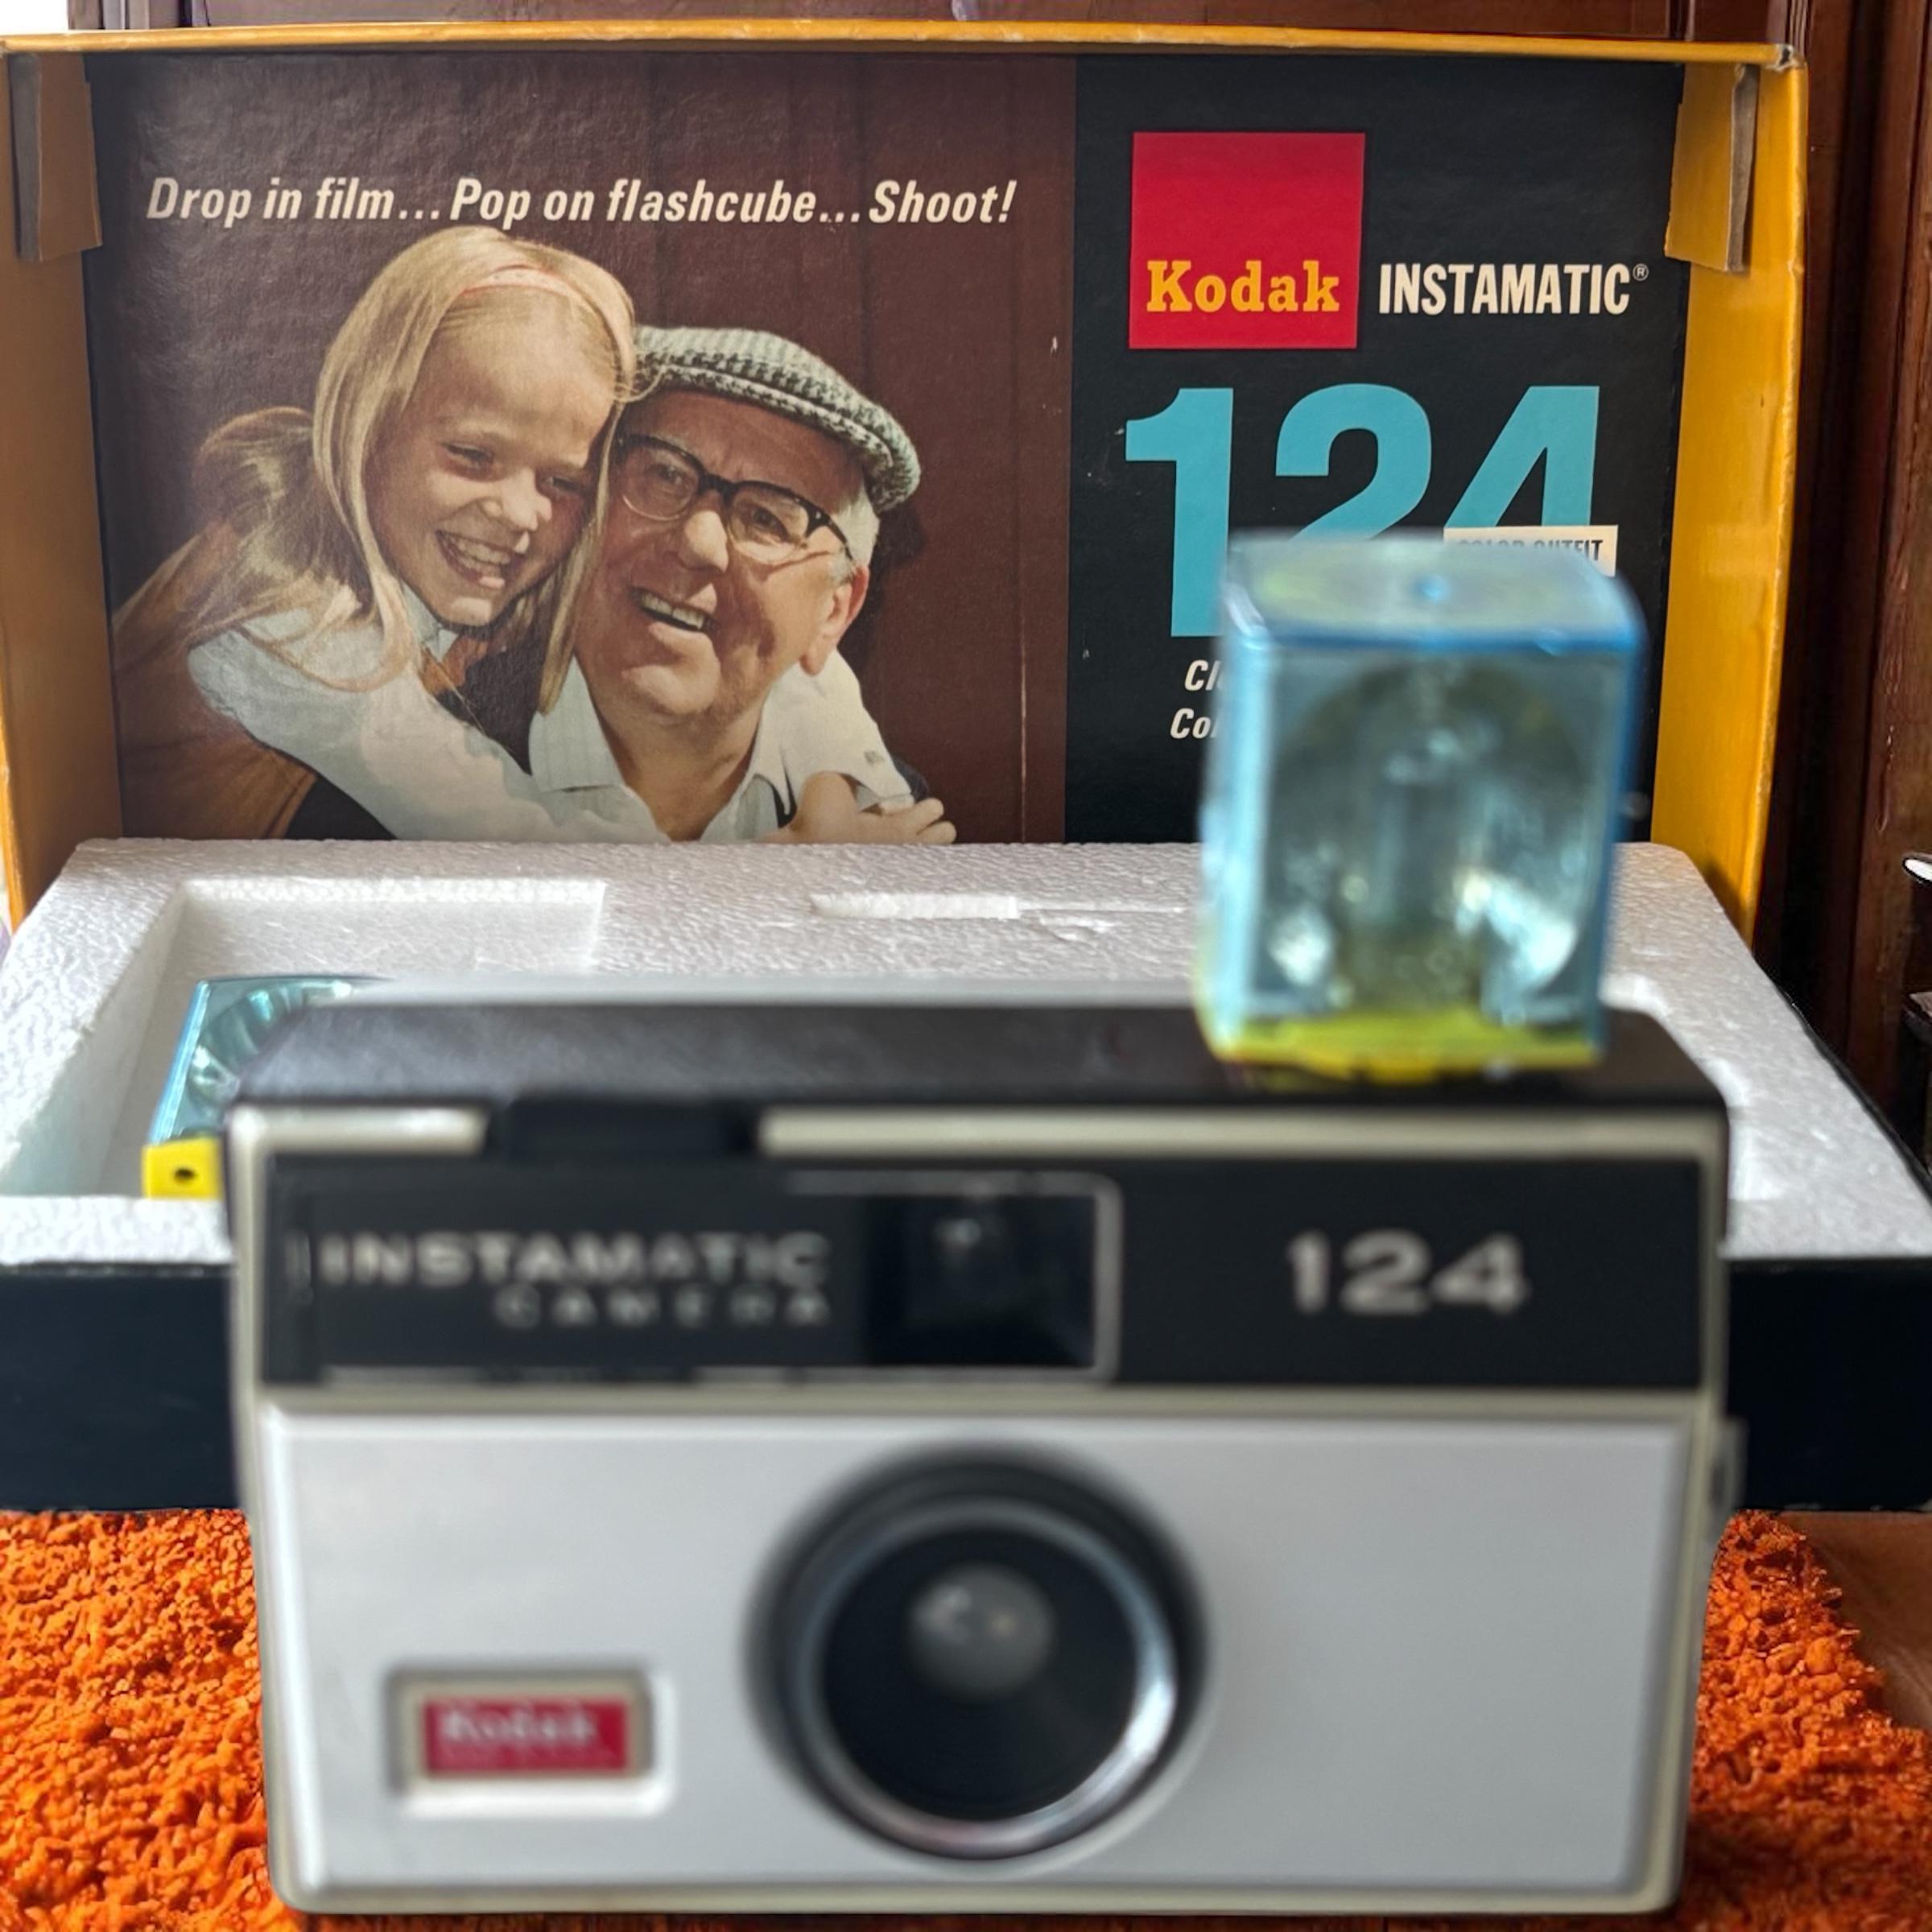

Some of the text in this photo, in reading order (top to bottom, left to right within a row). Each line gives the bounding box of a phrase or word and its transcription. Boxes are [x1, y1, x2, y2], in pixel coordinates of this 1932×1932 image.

[147, 176, 250, 229] Drop
[262, 177, 303, 220] in
[543, 189, 594, 221] on
[869, 180, 1018, 224] Shoot!
[1146, 260, 1340, 312] Kodak
[319, 1231, 829, 1288] INSTAMATIC
[1288, 1228, 1530, 1316] 124
